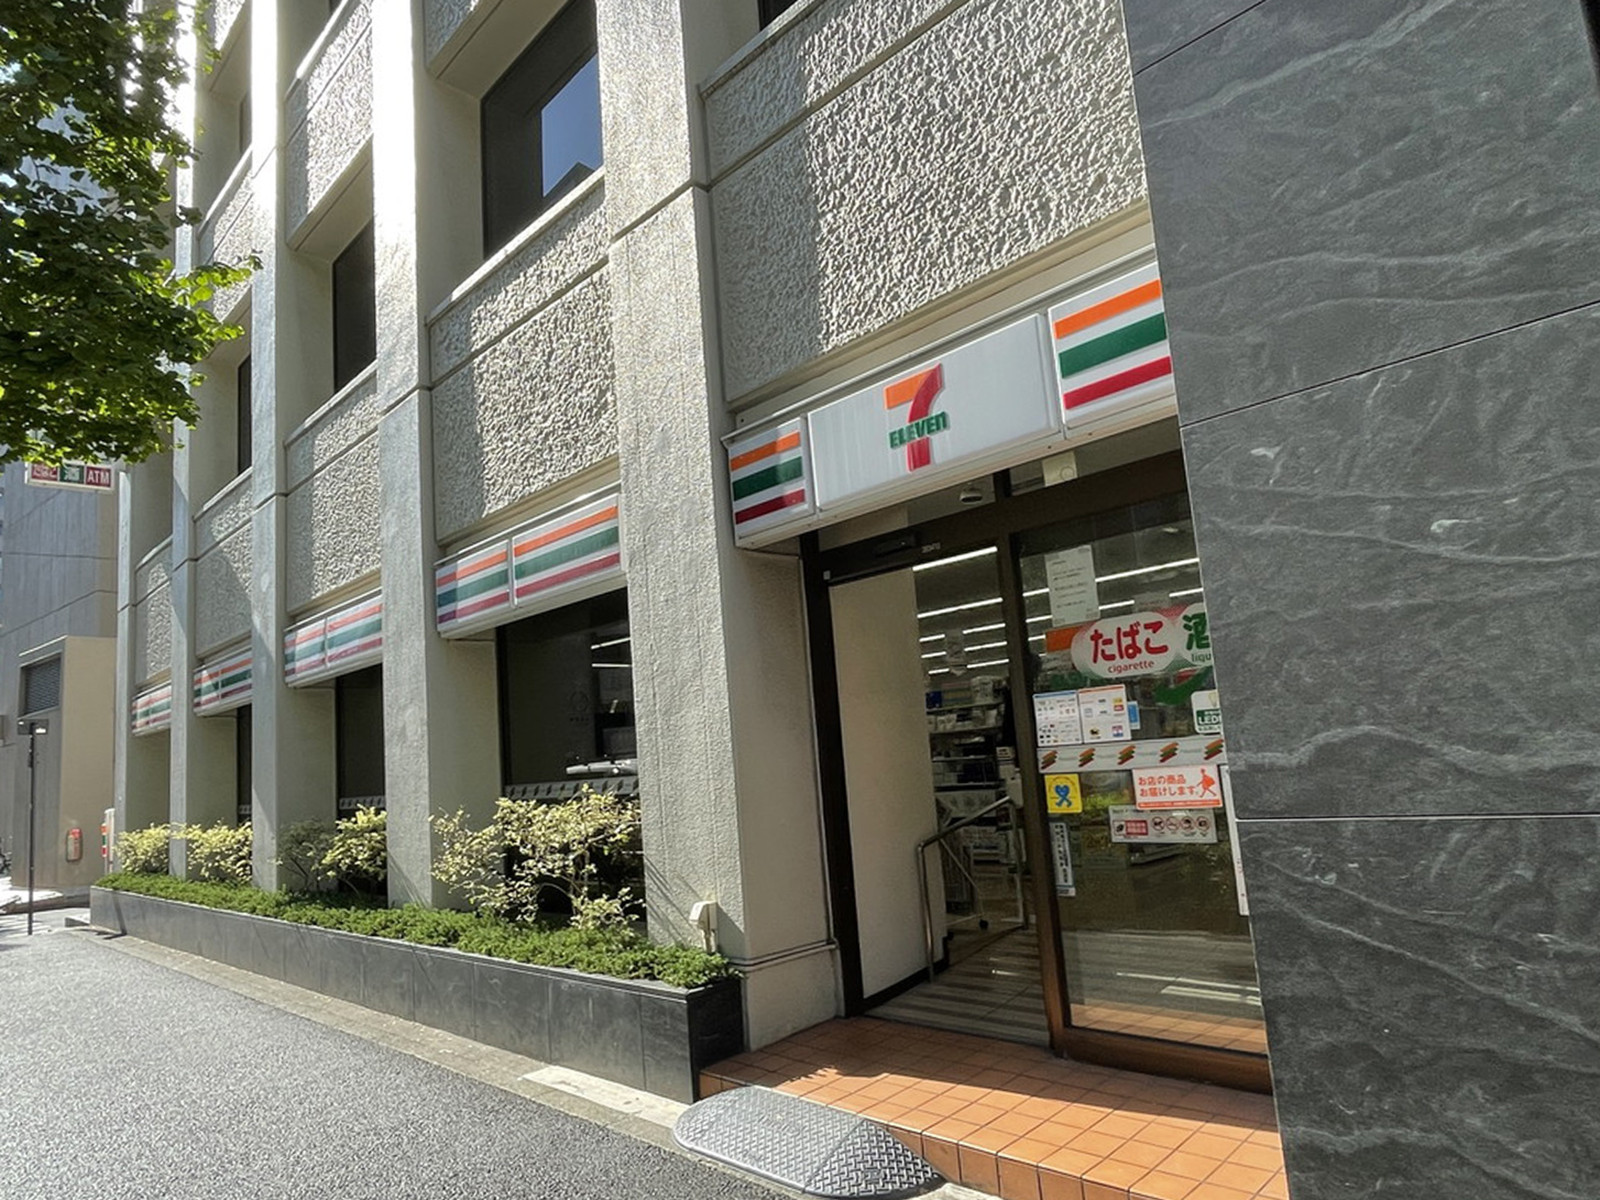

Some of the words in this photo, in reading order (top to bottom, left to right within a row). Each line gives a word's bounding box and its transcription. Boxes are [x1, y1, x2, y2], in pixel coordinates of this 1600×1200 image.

[884, 361, 945, 472] 7
[87, 469, 110, 485] ATM
[1090, 620, 1169, 664] たばこ
[1107, 659, 1155, 675] cigarette
[1138, 774, 1186, 786] お店の商品
